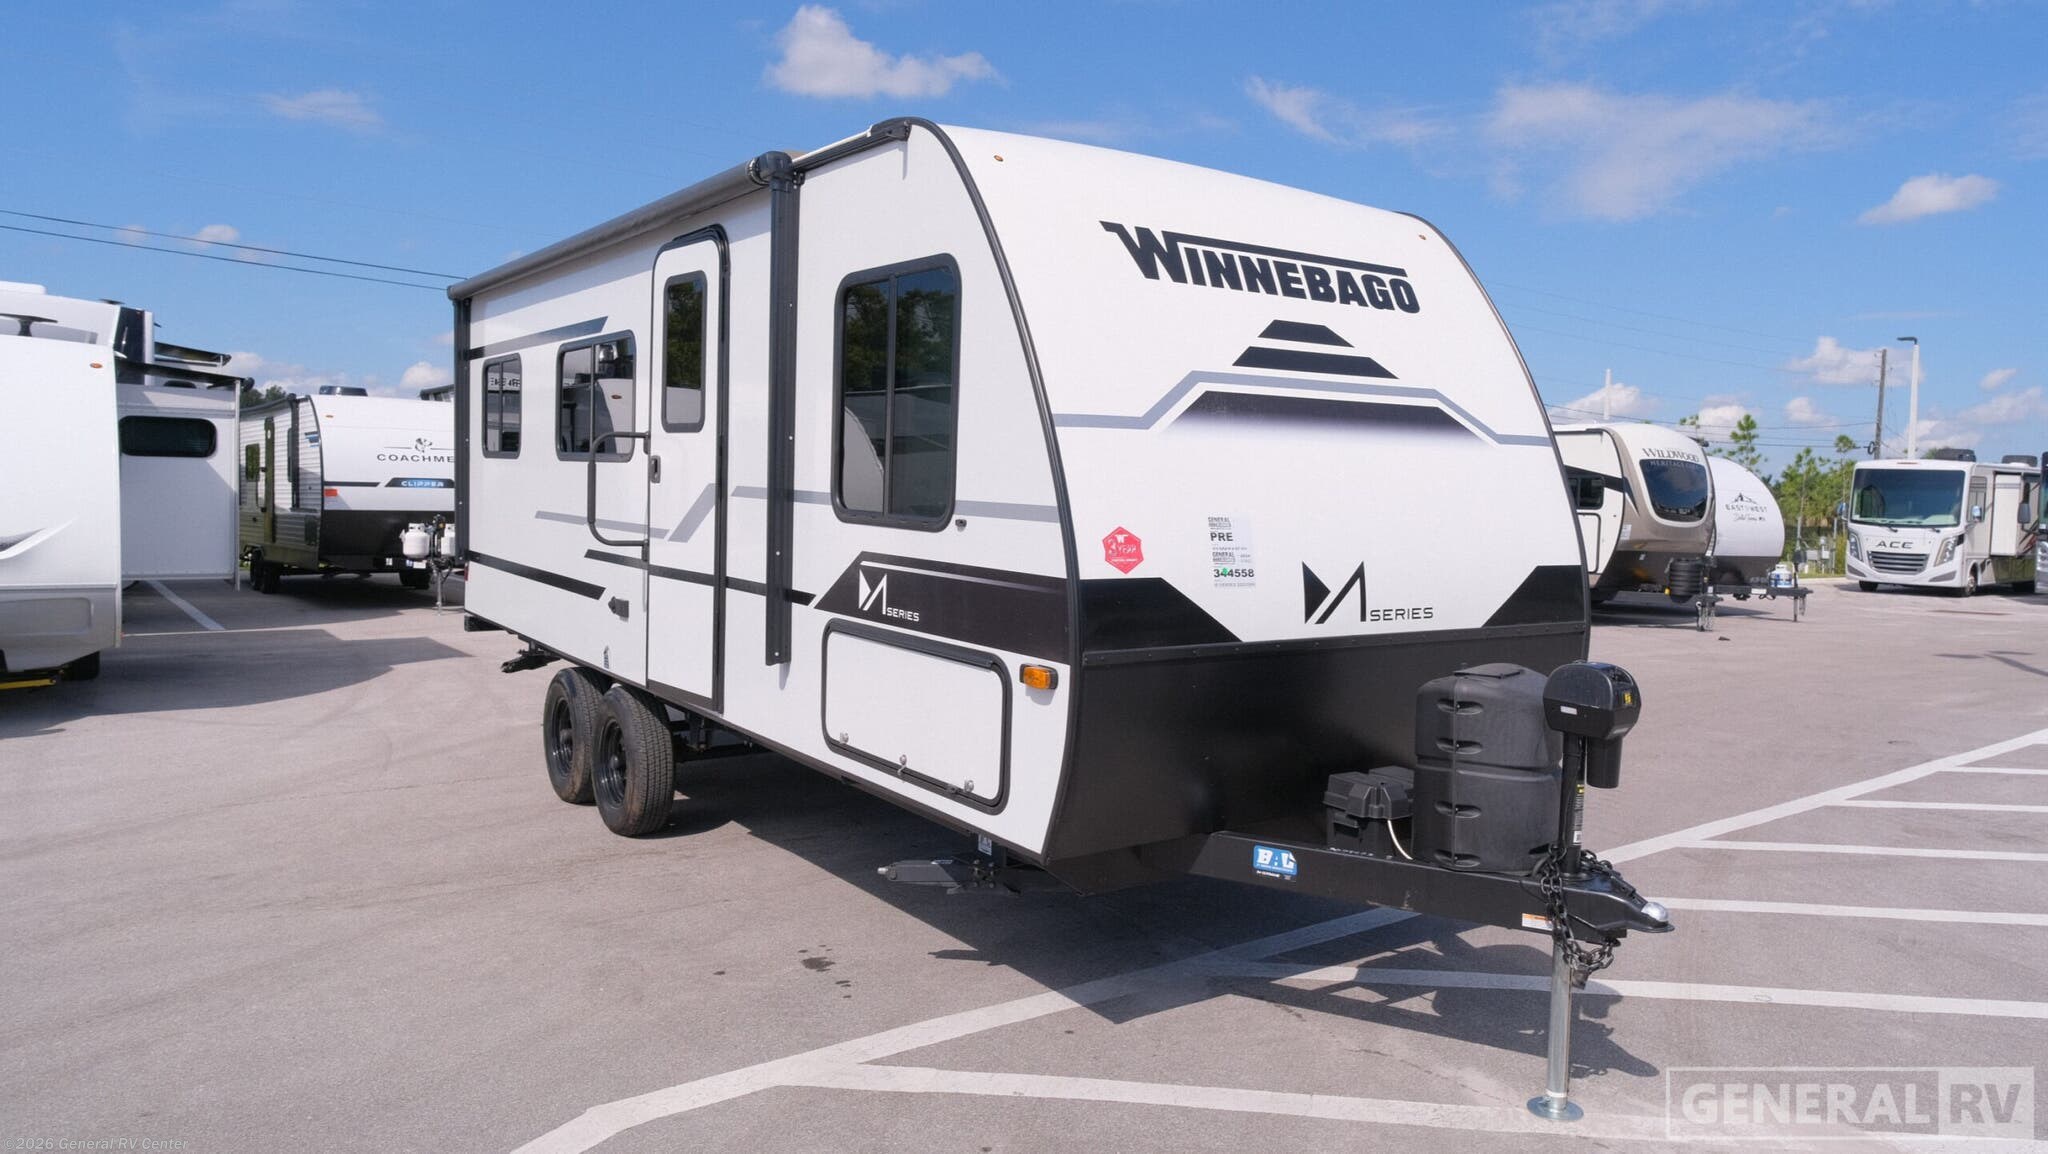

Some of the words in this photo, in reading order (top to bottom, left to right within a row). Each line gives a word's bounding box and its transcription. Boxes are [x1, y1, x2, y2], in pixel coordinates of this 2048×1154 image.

[1099, 220, 1421, 314] WINNEBAGO
[1641, 448, 1700, 463] WILDWOOD
[1210, 532, 1234, 542] PRE
[1876, 540, 1914, 550] ACE
[887, 607, 920, 622] SERIES
[1369, 607, 1434, 622] SERIES
